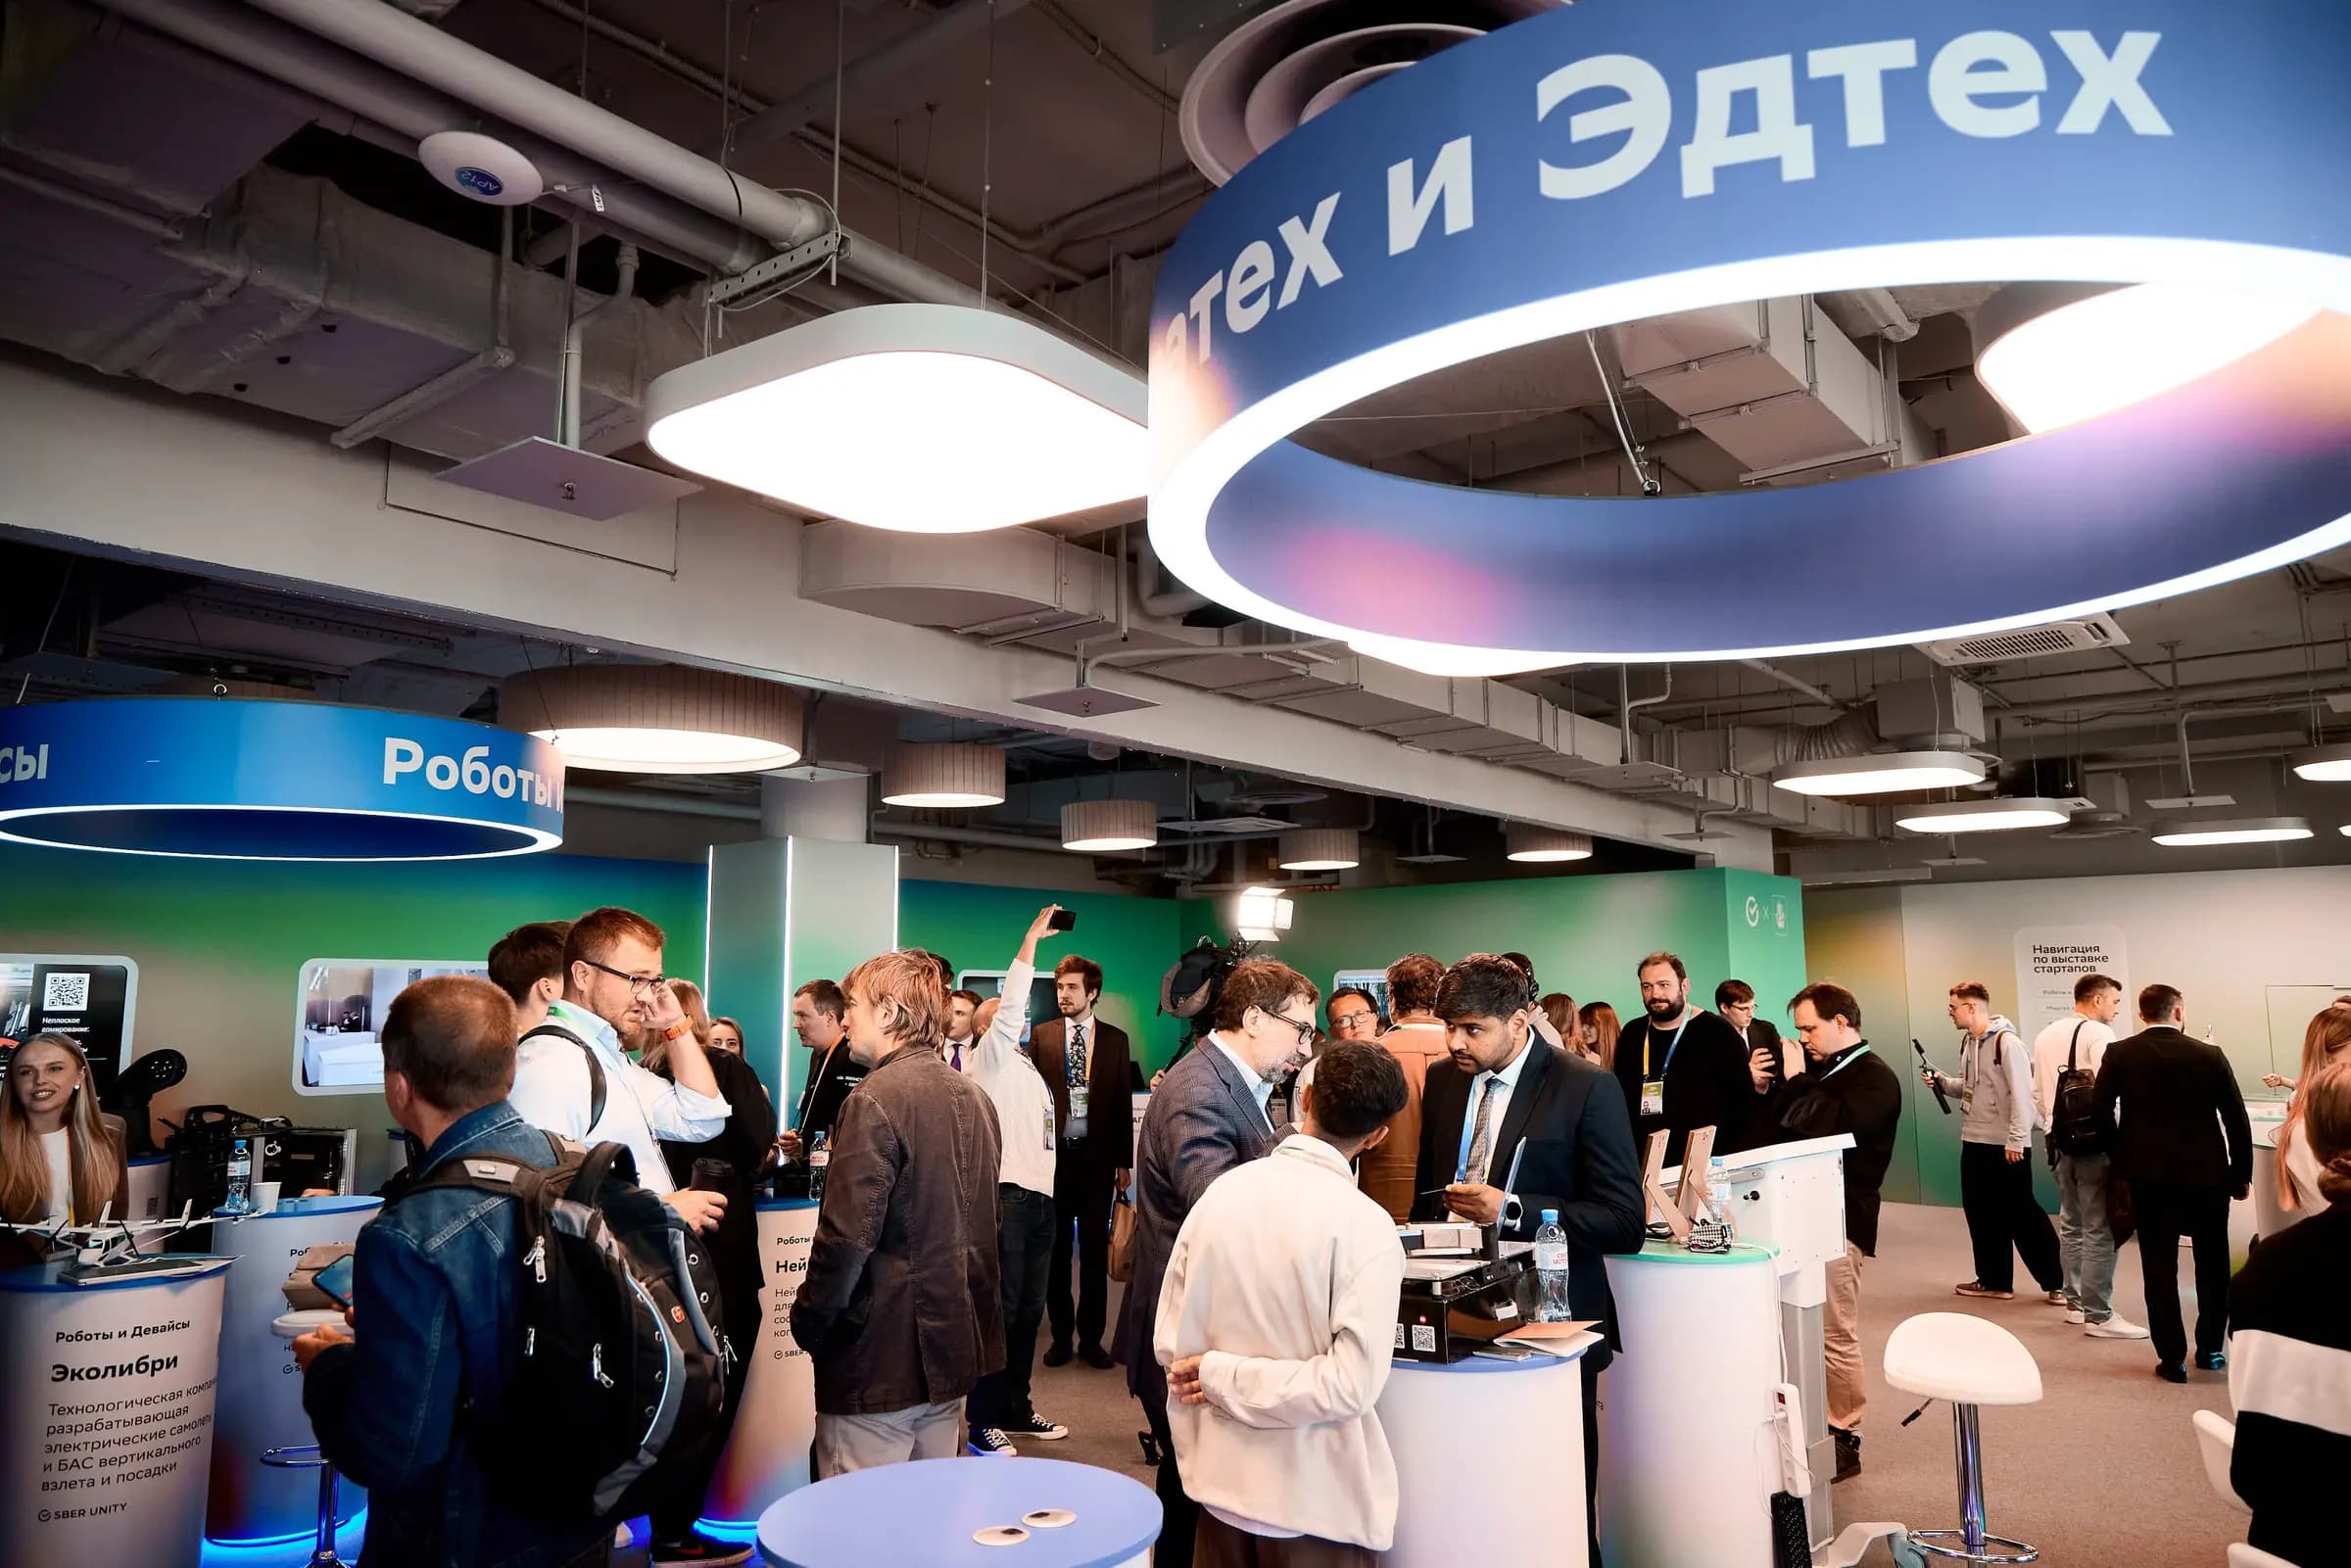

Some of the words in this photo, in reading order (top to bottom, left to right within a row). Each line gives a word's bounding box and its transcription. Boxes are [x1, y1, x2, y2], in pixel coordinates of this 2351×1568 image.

[1388, 135, 1473, 257] и
[1536, 29, 2174, 200] Эдтех
[383, 736, 552, 808] Роботы
[2033, 944, 2100, 954] Навигация
[2034, 965, 2096, 975] стартапов
[777, 1236, 811, 1245] Роботы
[775, 1287, 797, 1298] Ней
[56, 1330, 113, 1343] Роботы
[131, 1320, 190, 1339] Девайсы
[51, 1354, 178, 1383] Эколибри
[49, 1390, 183, 1416] Технологическая
[46, 1405, 189, 1438] разрабатывающая
[44, 1429, 166, 1453] электрические
[43, 1463, 52, 1473] и
[58, 1456, 94, 1472] БАС
[99, 1436, 201, 1467] вертикального
[41, 1478, 95, 1492] взлета
[101, 1476, 111, 1486] и
[116, 1461, 177, 1484] посадки
[54, 1508, 85, 1520] SBER
[89, 1502, 127, 1516] UNITY
